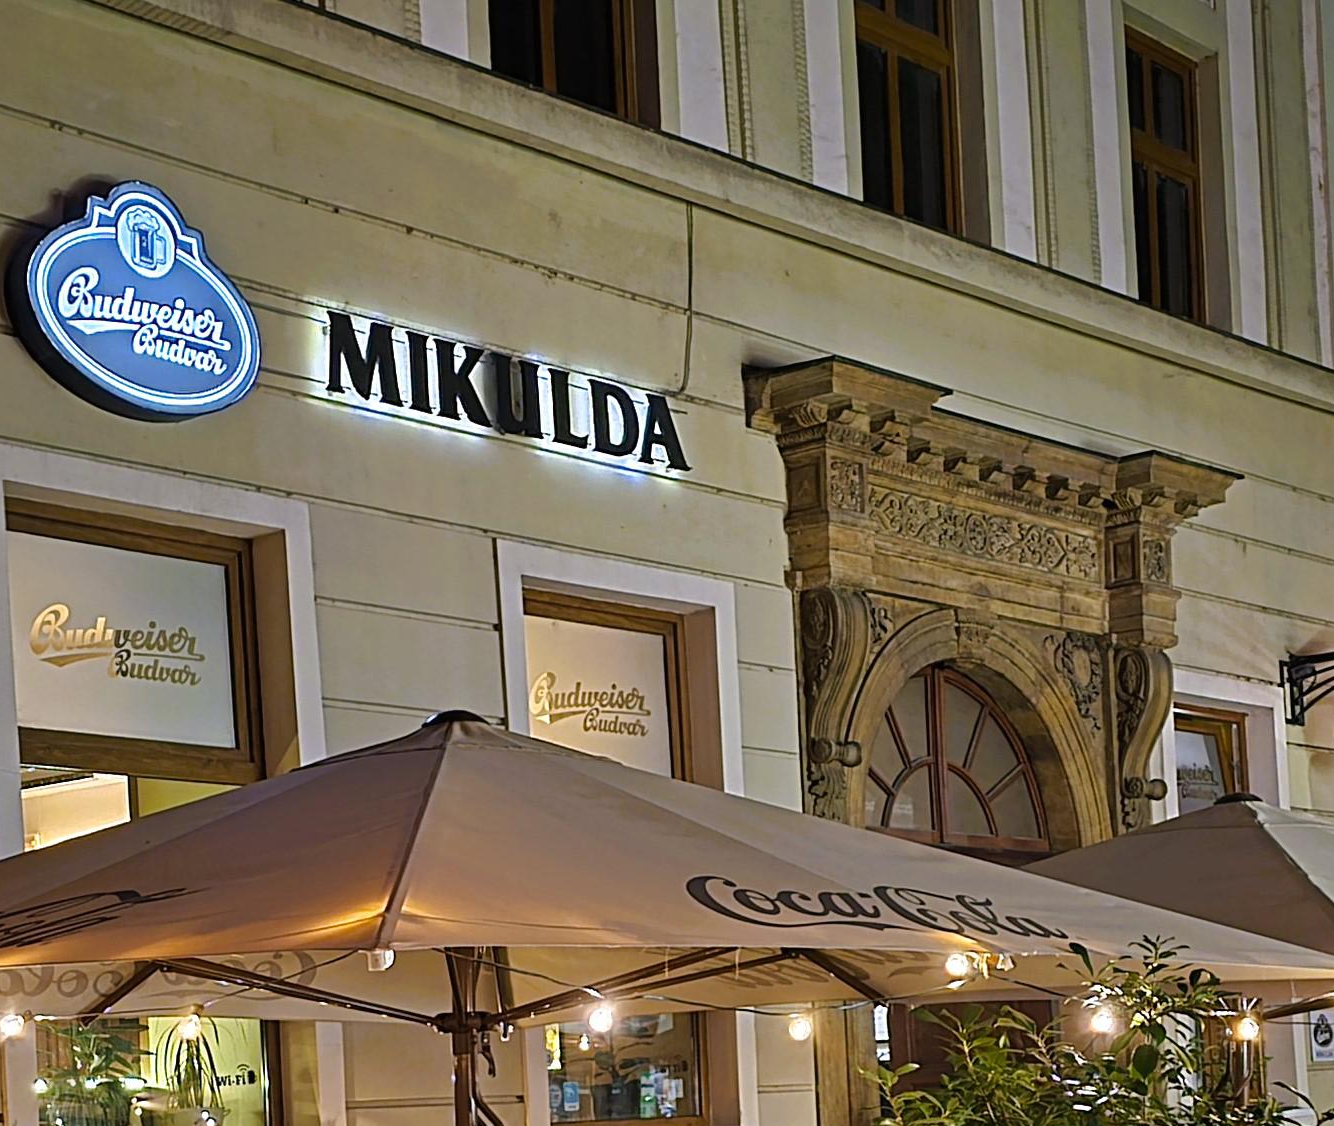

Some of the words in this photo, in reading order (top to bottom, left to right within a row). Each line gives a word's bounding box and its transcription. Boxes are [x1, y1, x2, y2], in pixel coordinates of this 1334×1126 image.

[58, 266, 231, 350] Budweiser
[133, 324, 227, 375] Budvar
[326, 310, 692, 471] MIKULDA
[29, 602, 205, 662] Budweiser
[107, 649, 202, 686] Budvar
[529, 671, 652, 716] Budweiser
[583, 707, 648, 737] Budvar
[686, 875, 1068, 941] Coca-Cola
